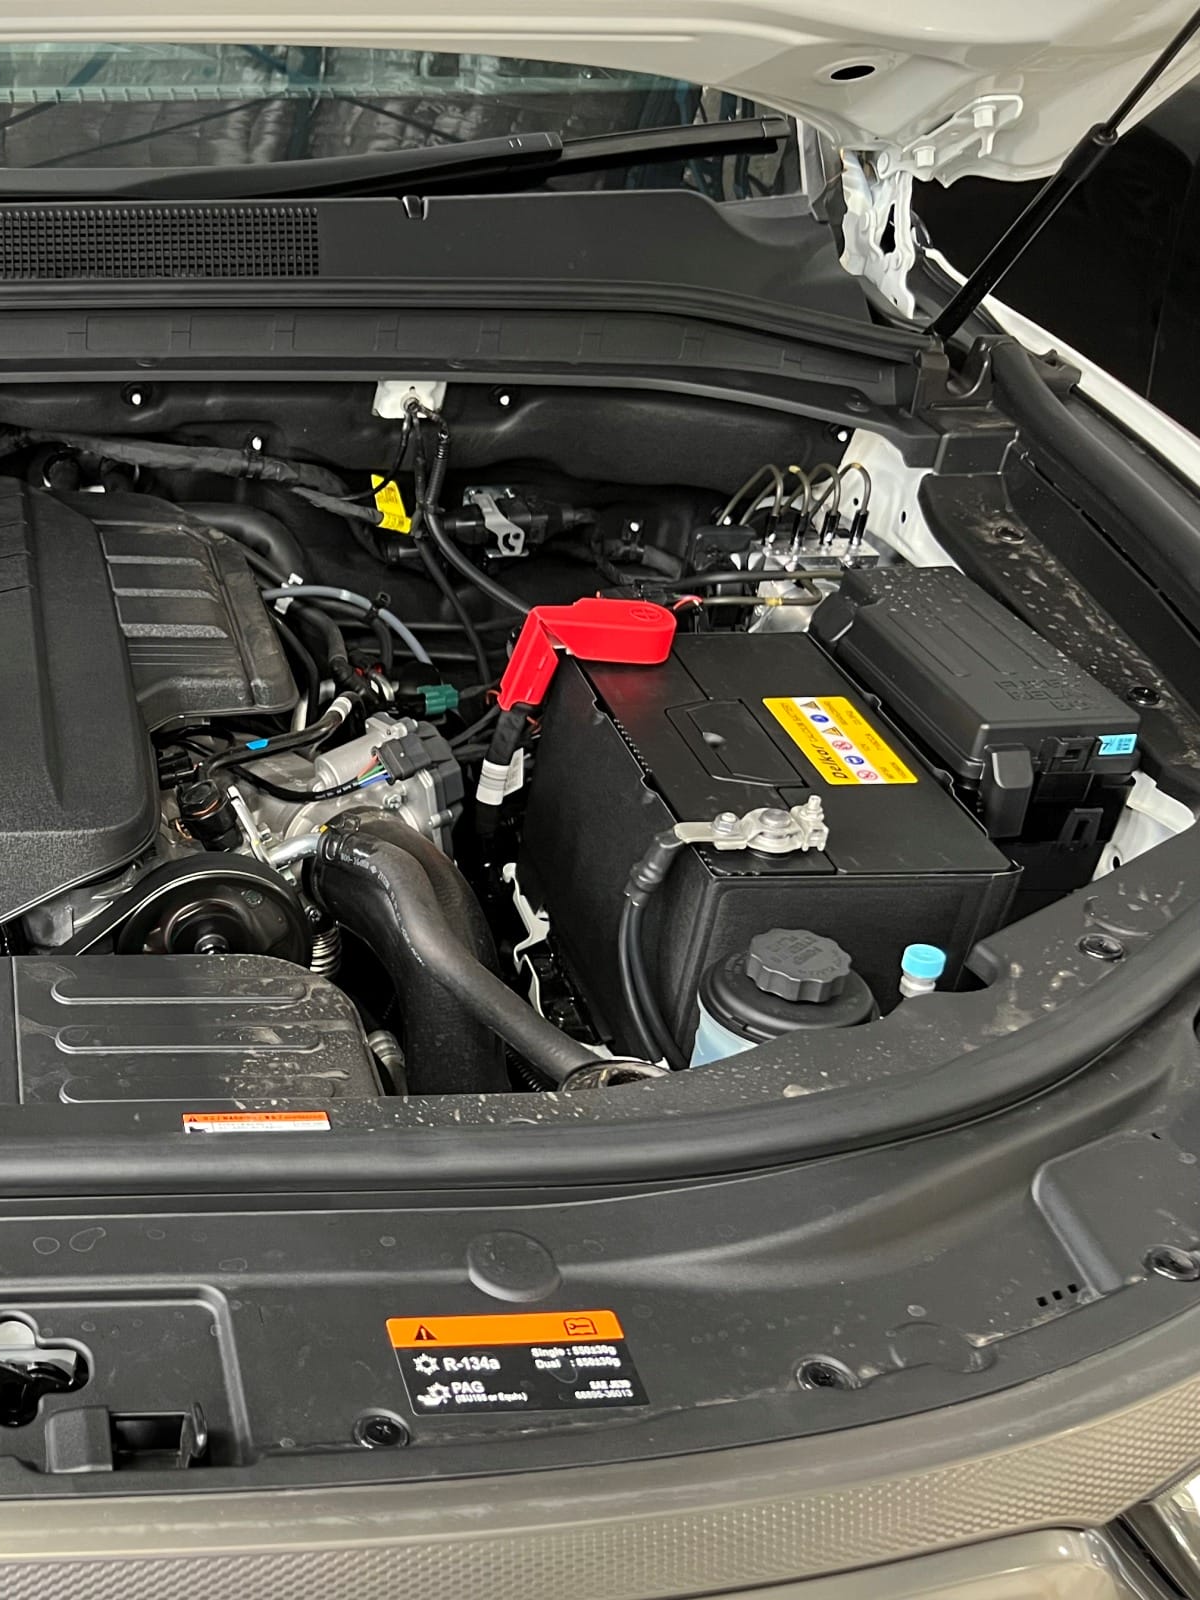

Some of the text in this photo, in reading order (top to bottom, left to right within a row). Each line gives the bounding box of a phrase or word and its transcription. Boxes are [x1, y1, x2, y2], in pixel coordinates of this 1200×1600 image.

[811, 743, 848, 779] Delkor
[531, 1347, 565, 1358] Single
[443, 1356, 501, 1371] R-134a
[535, 1359, 561, 1369] Dual
[451, 1381, 485, 1395] PAG
